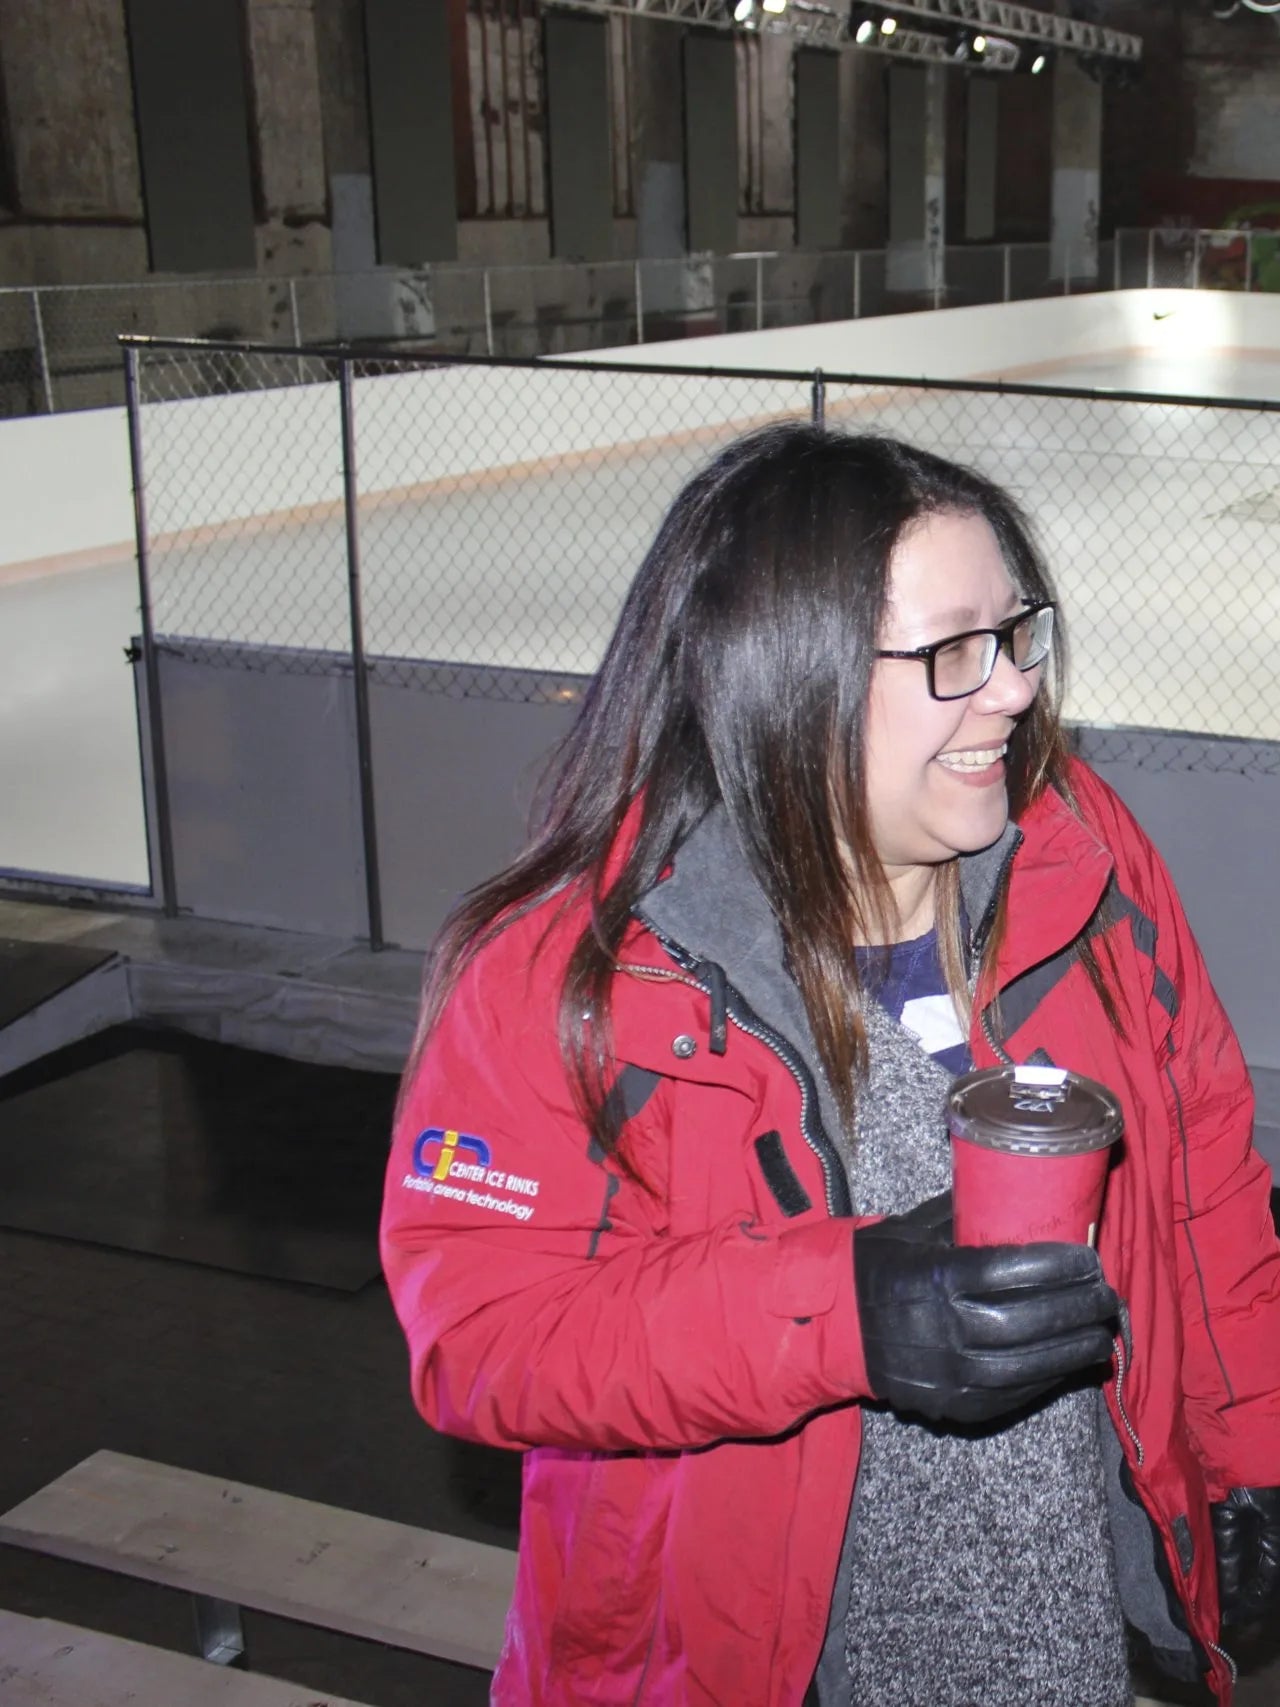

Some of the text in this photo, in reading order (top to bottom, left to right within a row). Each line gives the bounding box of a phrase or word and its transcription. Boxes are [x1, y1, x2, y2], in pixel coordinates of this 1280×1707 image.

[449, 1161, 540, 1196] CENTER ICE RINKS
[434, 1183, 466, 1201] arena
[466, 1190, 535, 1220] technology
